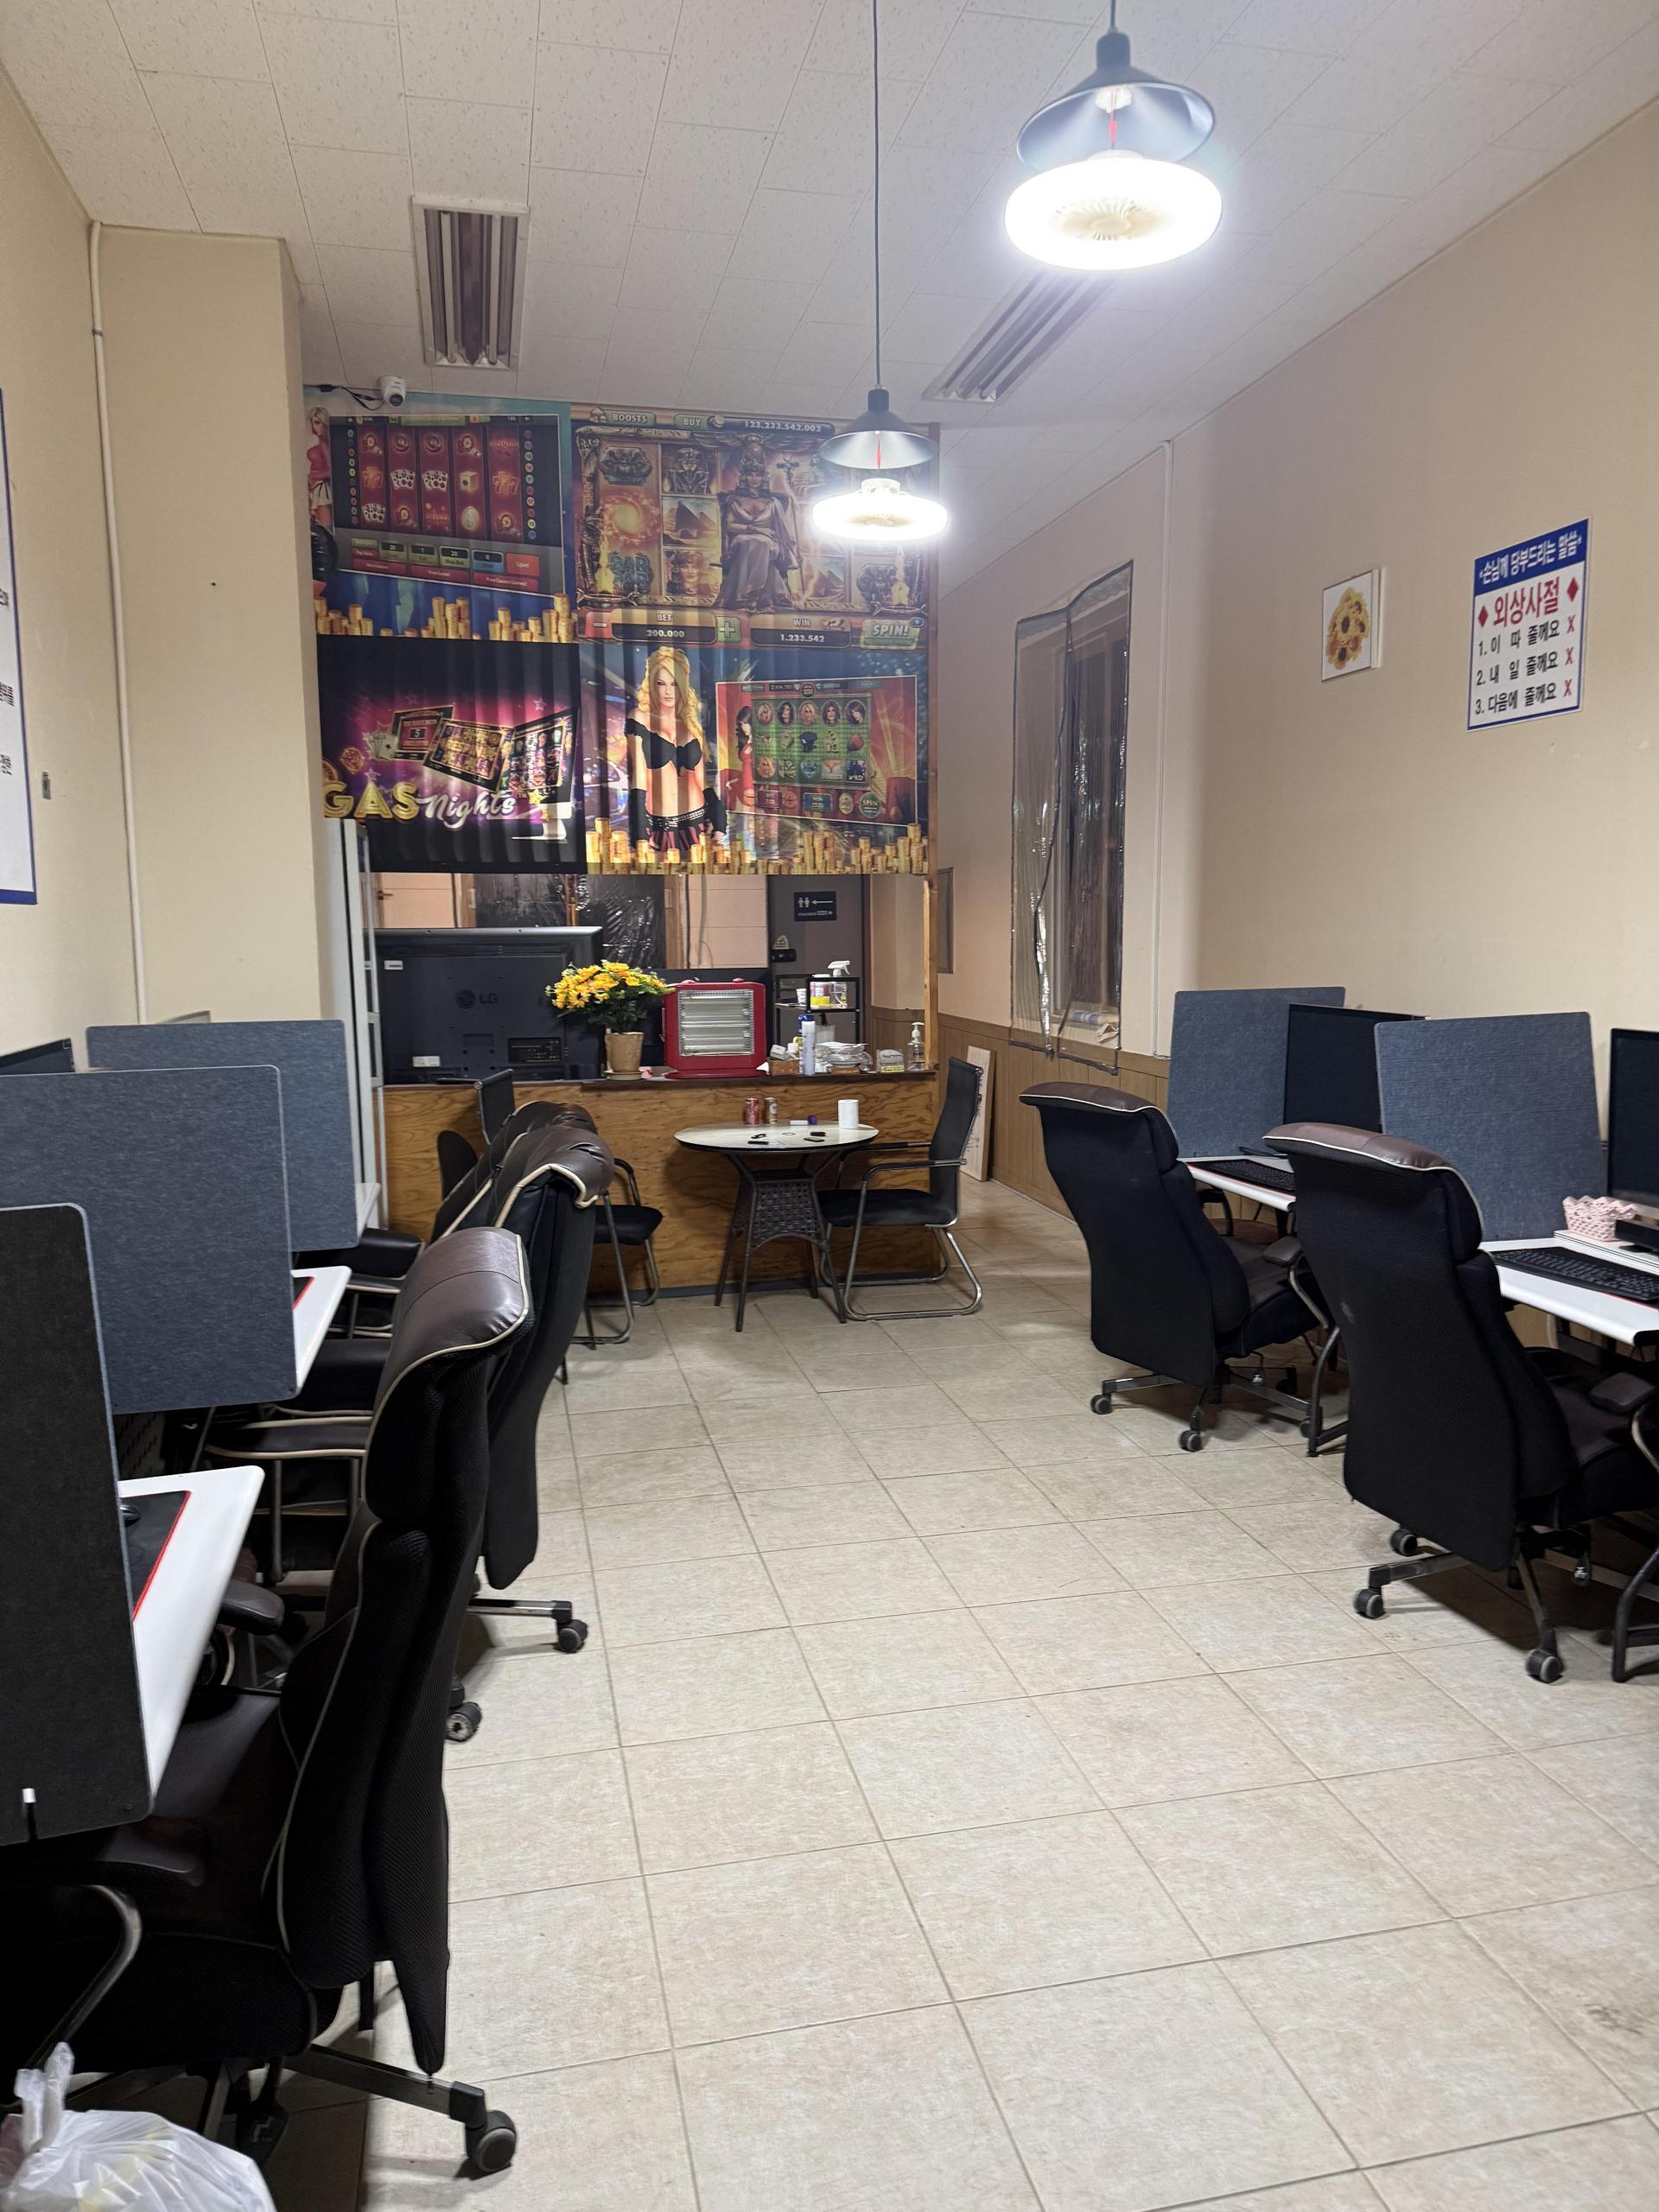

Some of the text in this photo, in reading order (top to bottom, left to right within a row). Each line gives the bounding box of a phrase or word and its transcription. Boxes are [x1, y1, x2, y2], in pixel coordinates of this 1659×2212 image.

[612, 413, 648, 423] BOOSTS
[683, 416, 701, 426] BUY
[1483, 554, 1510, 585] 손님께
[1558, 531, 1578, 560] 말씀
[1493, 576, 1560, 627] 외상사절
[657, 613, 673, 622] BET
[793, 618, 810, 626] WIN
[646, 629, 685, 638] 200.000
[872, 625, 910, 638] SPIN!
[780, 633, 825, 643] 1.233.542
[1488, 690, 1518, 713] 다음에
[414, 728, 421, 738] 5
[479, 992, 499, 1004] LG
